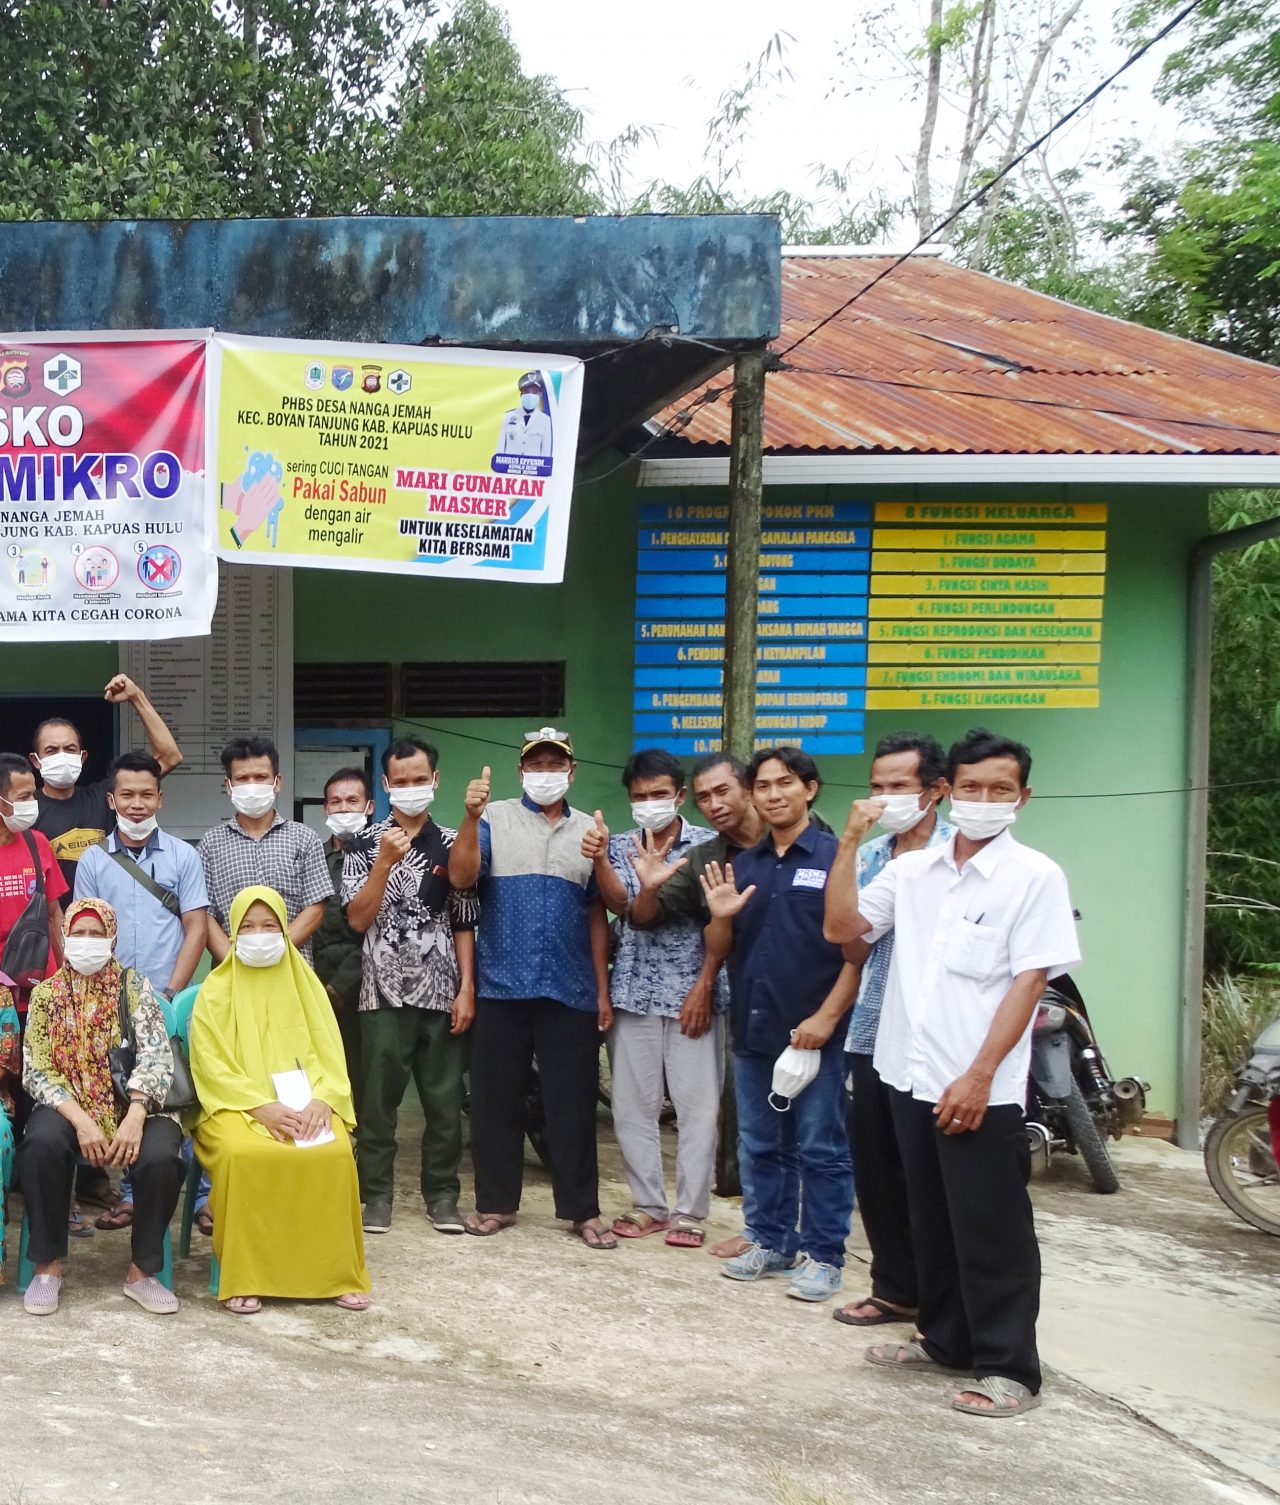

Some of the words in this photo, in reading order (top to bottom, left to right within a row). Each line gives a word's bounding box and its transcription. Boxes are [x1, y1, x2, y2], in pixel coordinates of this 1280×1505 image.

[282, 396, 313, 412] PHBS
[316, 398, 346, 413] DESA
[349, 400, 390, 416] NANGA
[392, 404, 432, 419] JEMAH
[238, 410, 264, 425] KEC.
[266, 412, 304, 428] BOYAN
[307, 414, 360, 432] TANJUNG
[362, 417, 390, 433] KAB.
[392, 420, 438, 437] KAPUAS
[440, 423, 473, 440] HULU
[318, 432, 358, 448] TAHUN
[360, 435, 390, 450] 2021
[286, 460, 317, 476] sering
[320, 462, 344, 476] CUCI
[346, 463, 390, 478] TANGAN
[293, 477, 336, 500] Pakai
[339, 480, 387, 504] Sabun
[396, 470, 447, 492] MARI
[452, 474, 545, 498] GUNAKAN
[428, 494, 508, 517] MASKER
[920, 506, 978, 518] FUNGSI
[984, 506, 1076, 518] KELUARGA
[0, 511, 49, 522] NANGA
[54, 509, 104, 522] JEMAH
[304, 504, 352, 525] dengan
[355, 509, 372, 524] air
[44, 524, 78, 537] KAB.
[83, 523, 140, 536] KAPUAS
[146, 522, 184, 534] HULU
[400, 520, 442, 536] UNTUK
[445, 523, 533, 543] KESELAMATAN
[308, 527, 364, 546] mengalir
[806, 531, 856, 544] PANCASILA
[956, 534, 993, 545] FUNGSI
[996, 534, 1036, 545] AGAMA
[12, 545, 17, 556] 3
[74, 544, 80, 554] 4
[138, 542, 144, 552] 5
[418, 538, 447, 555] KITA
[450, 540, 510, 559] BERSAMA
[952, 556, 990, 568] FUNGSI
[938, 580, 976, 591] FUNGSI
[980, 580, 1010, 591] CINTA
[32, 610, 66, 621] KITA
[71, 610, 119, 620] CEGAH
[124, 606, 182, 619] CORONA
[930, 603, 968, 614] FUNGSI
[972, 603, 1054, 614] PERLINDUNGAN
[652, 624, 706, 637] PERUMAHAN
[826, 623, 864, 636] TANGGA
[892, 626, 929, 637] FUNGSI
[932, 626, 1000, 637] REPRODUKSI
[1030, 626, 1092, 638] KESEHATAN
[937, 648, 974, 659] FUNGSI
[896, 671, 932, 682] FUNGSI
[934, 694, 972, 705] FUNGSI
[975, 694, 1046, 705] LINGKUNGAN
